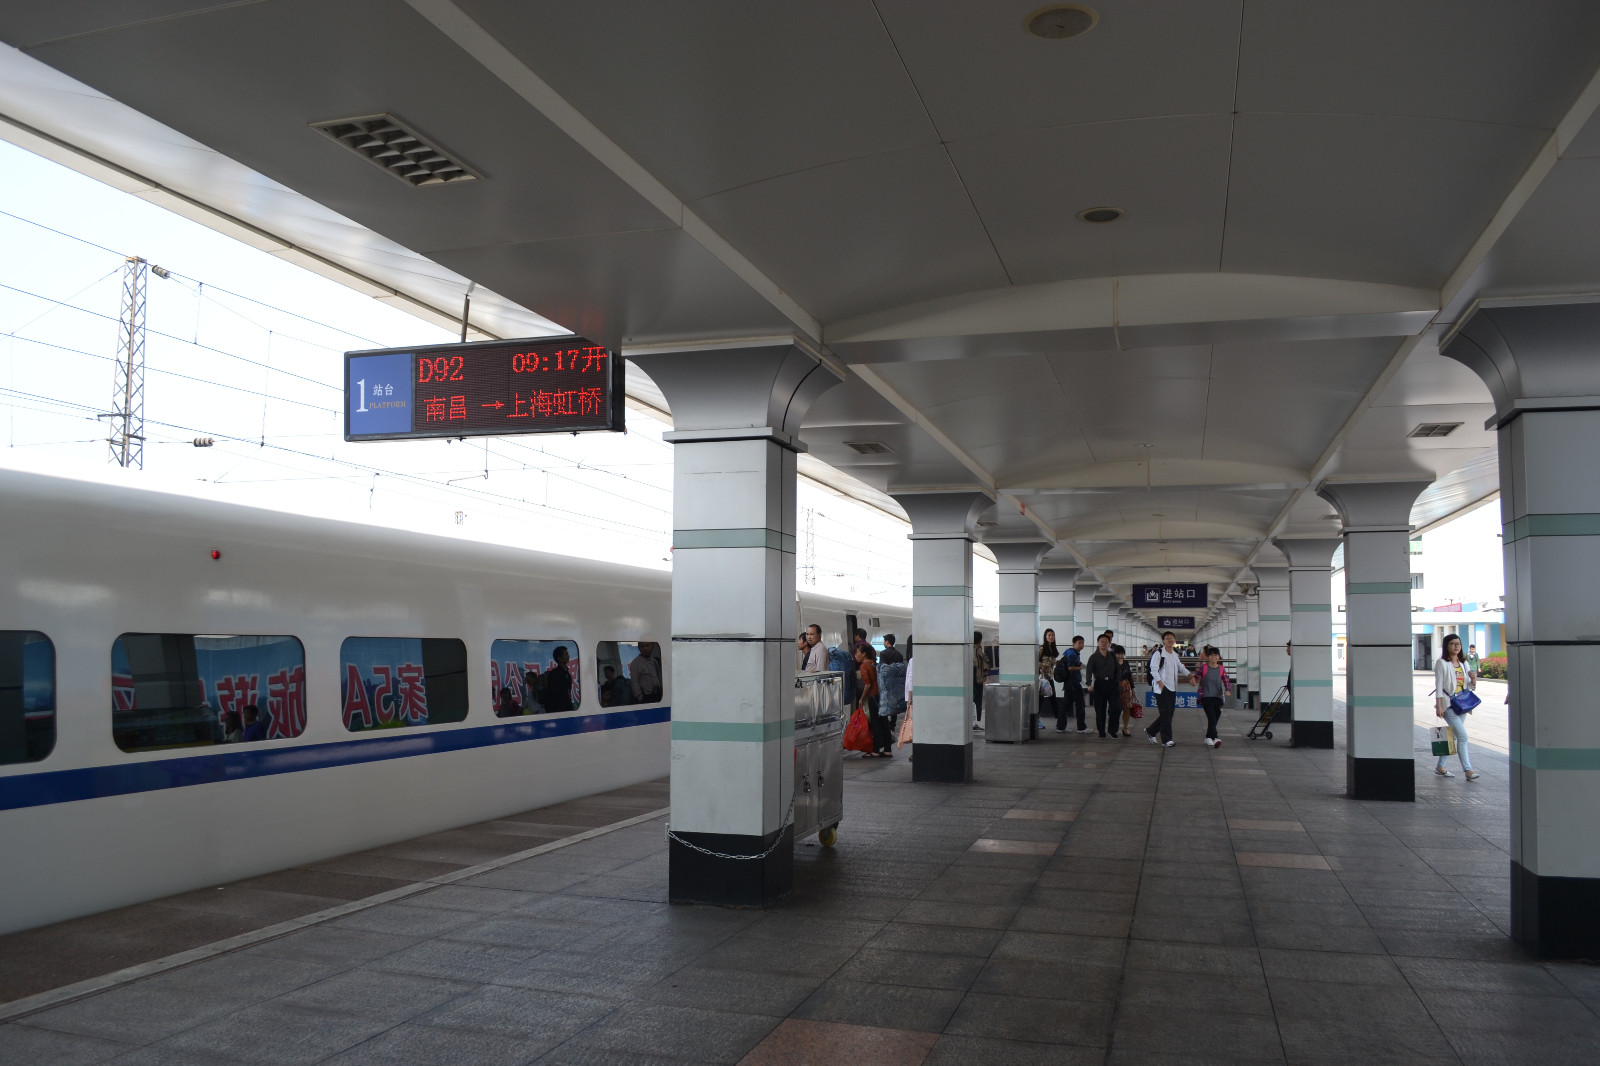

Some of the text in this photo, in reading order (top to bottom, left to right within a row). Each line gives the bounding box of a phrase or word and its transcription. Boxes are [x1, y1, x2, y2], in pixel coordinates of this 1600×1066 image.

[418, 356, 465, 383] D92
[512, 346, 608, 374] 09:17开
[356, 378, 369, 413] 1
[372, 383, 394, 397] 站台
[369, 400, 407, 409] PLATFORM
[423, 386, 603, 422] 南昌 上海虹桥
[1162, 588, 1196, 599] 进站口
